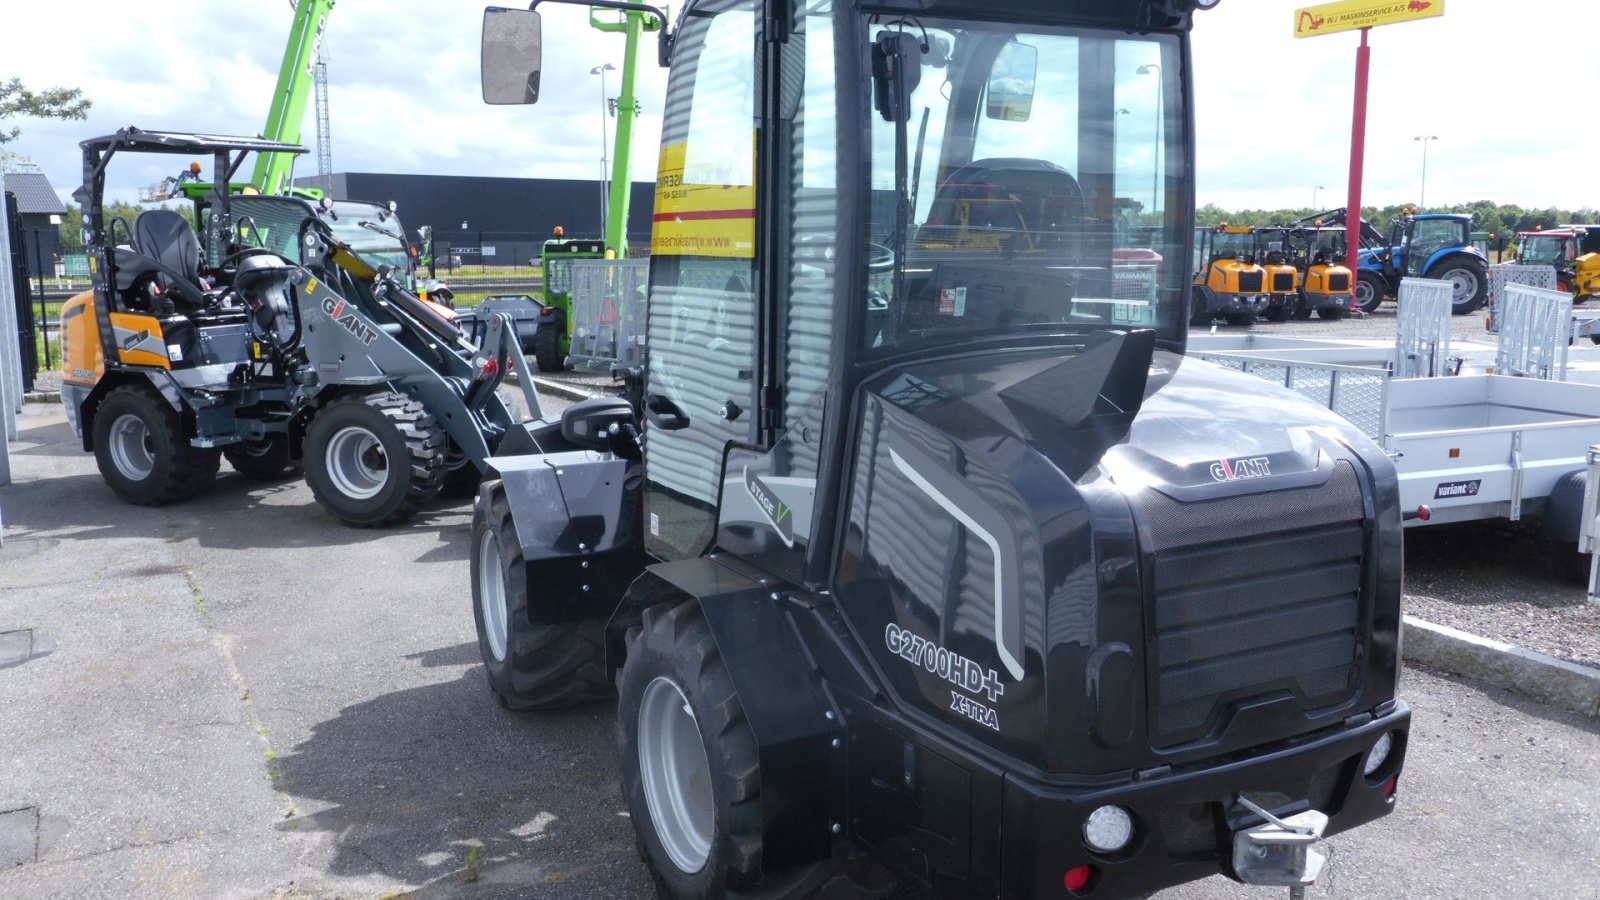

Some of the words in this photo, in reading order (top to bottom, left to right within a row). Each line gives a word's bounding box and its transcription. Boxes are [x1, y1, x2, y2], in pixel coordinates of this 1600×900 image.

[1340, 6, 1393, 22] MASKINSERVICE
[1394, 4, 1405, 12] A/S
[322, 297, 378, 346] GIANT
[1210, 457, 1271, 482] GIANT
[1438, 483, 1467, 496] variant
[750, 481, 774, 516] STAGE
[777, 501, 791, 524] V
[885, 623, 1004, 702] G2700HD+
[950, 690, 1000, 731] X-TRA
